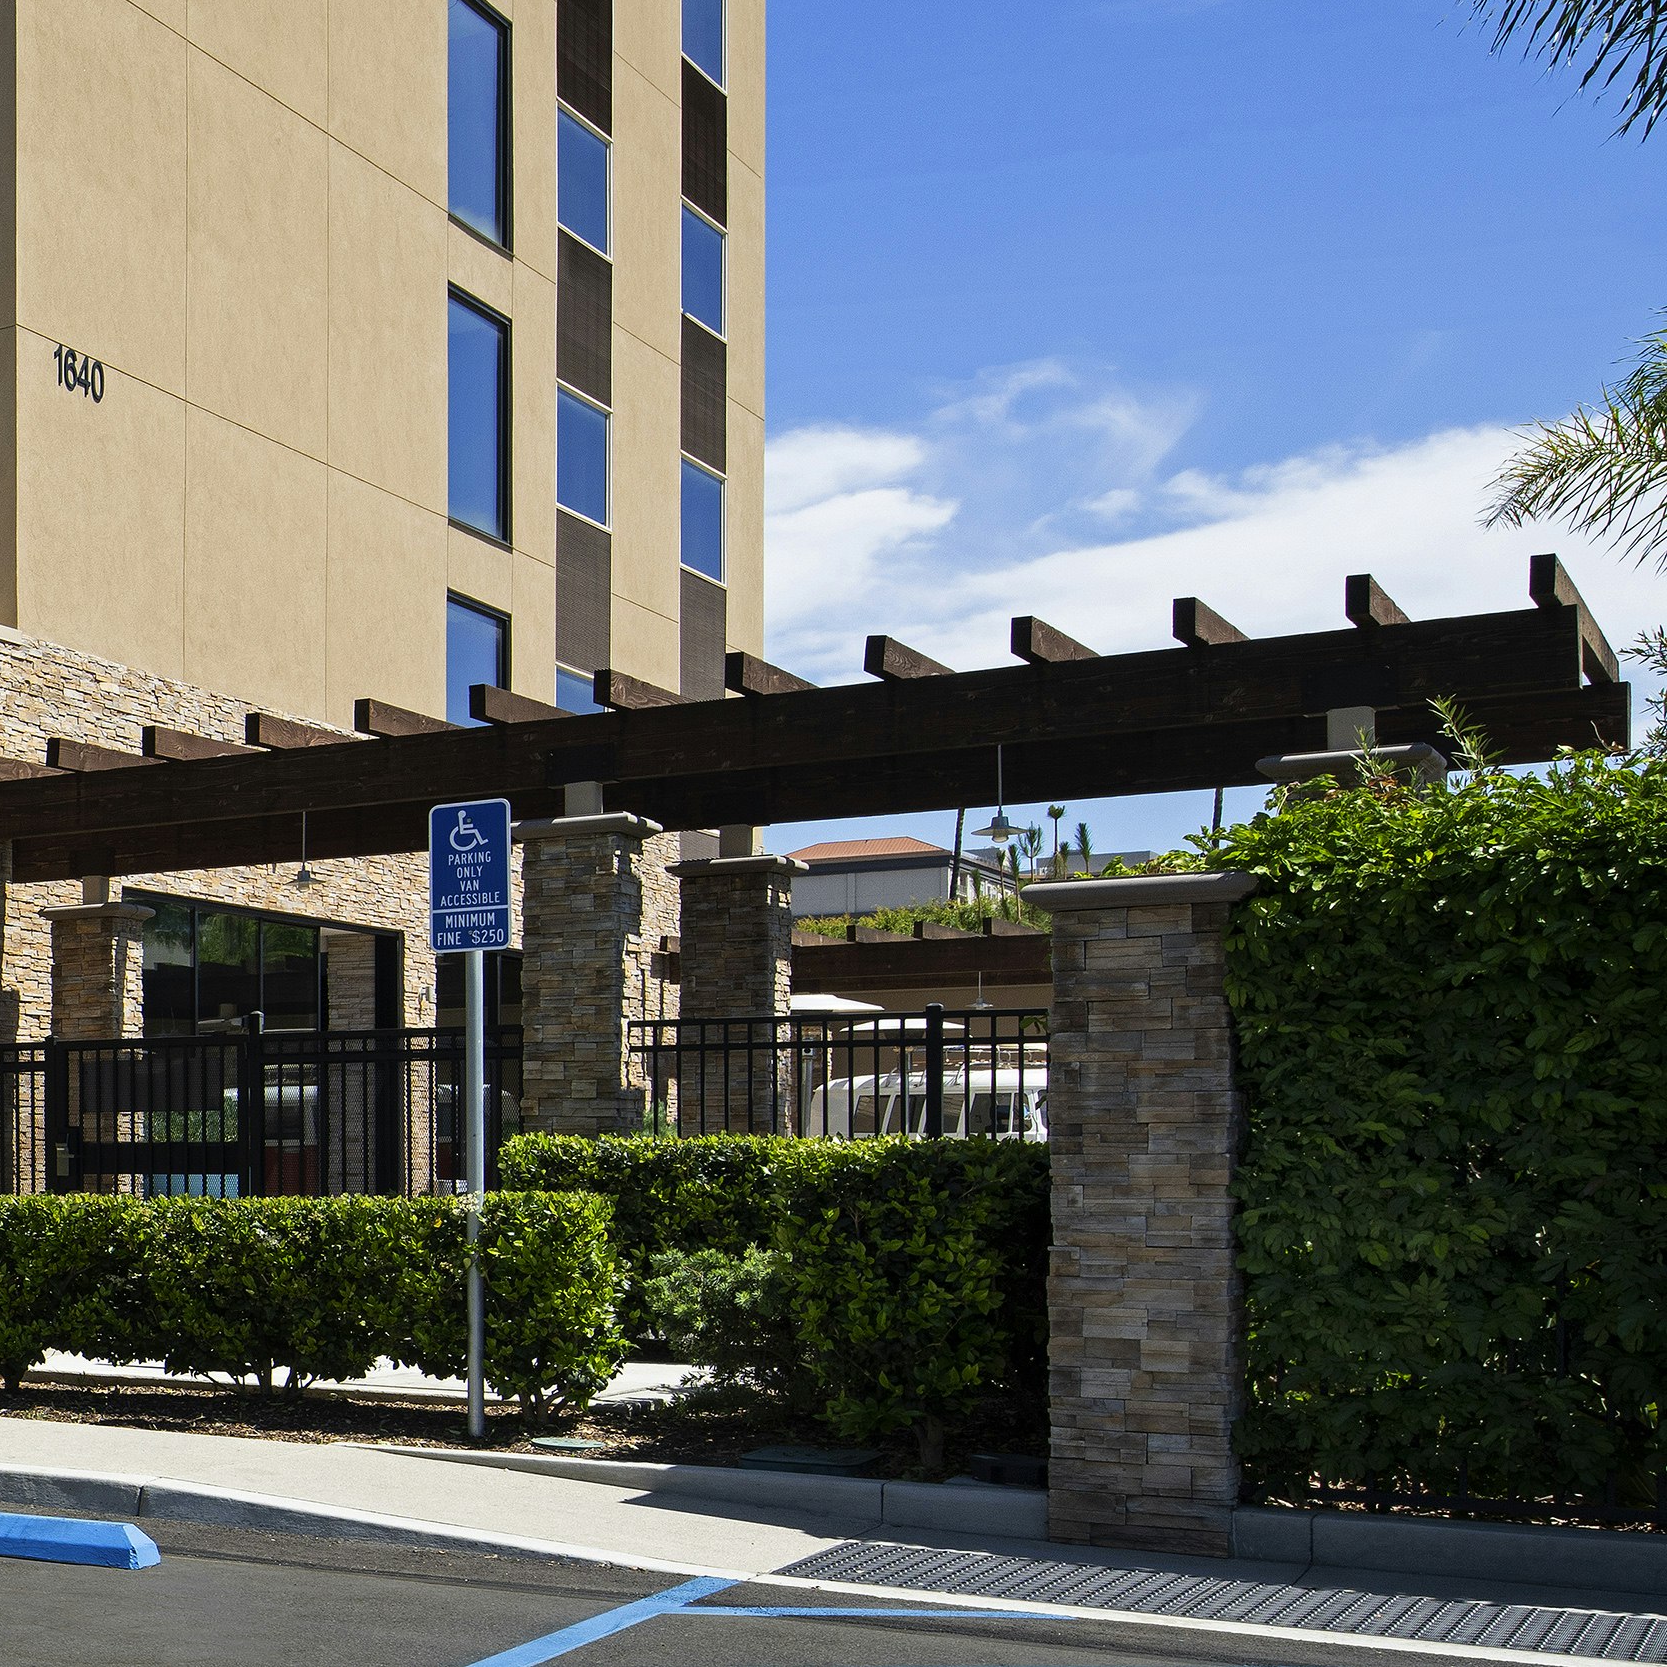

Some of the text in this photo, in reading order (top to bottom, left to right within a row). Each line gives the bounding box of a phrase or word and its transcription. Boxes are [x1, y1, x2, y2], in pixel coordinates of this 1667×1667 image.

[53, 343, 105, 404] 1640
[448, 851, 491, 866] PARKING
[456, 865, 483, 879] ONLY
[460, 879, 479, 891] VAN
[440, 891, 500, 907] ACCESSIBLE
[445, 912, 495, 929] MINIMUM
[437, 928, 504, 946] FINE $250
